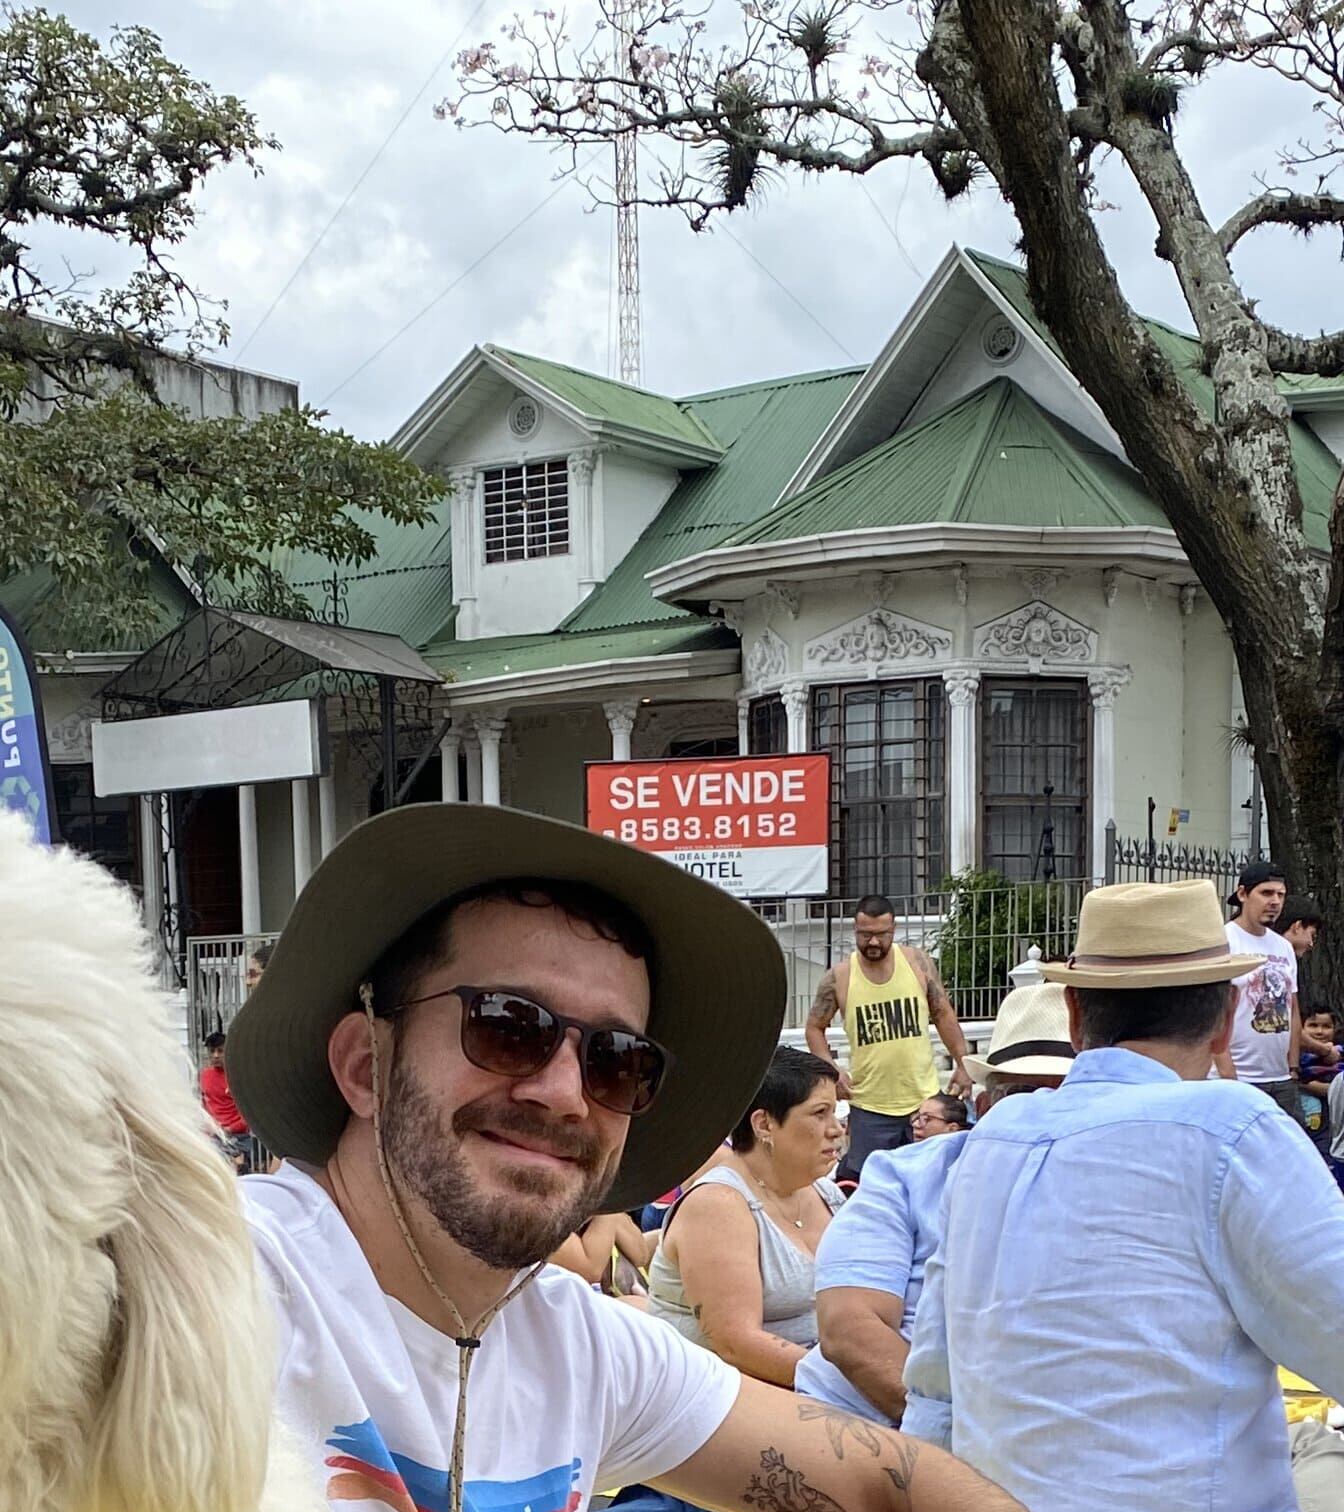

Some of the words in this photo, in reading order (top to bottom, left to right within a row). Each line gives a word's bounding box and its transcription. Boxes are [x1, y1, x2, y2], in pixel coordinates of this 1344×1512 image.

[609, 775, 660, 811] SE
[671, 769, 806, 808] VENDE
[620, 812, 797, 843] 8583.8152
[674, 852, 707, 862] IDEAL
[712, 850, 743, 861] PARA
